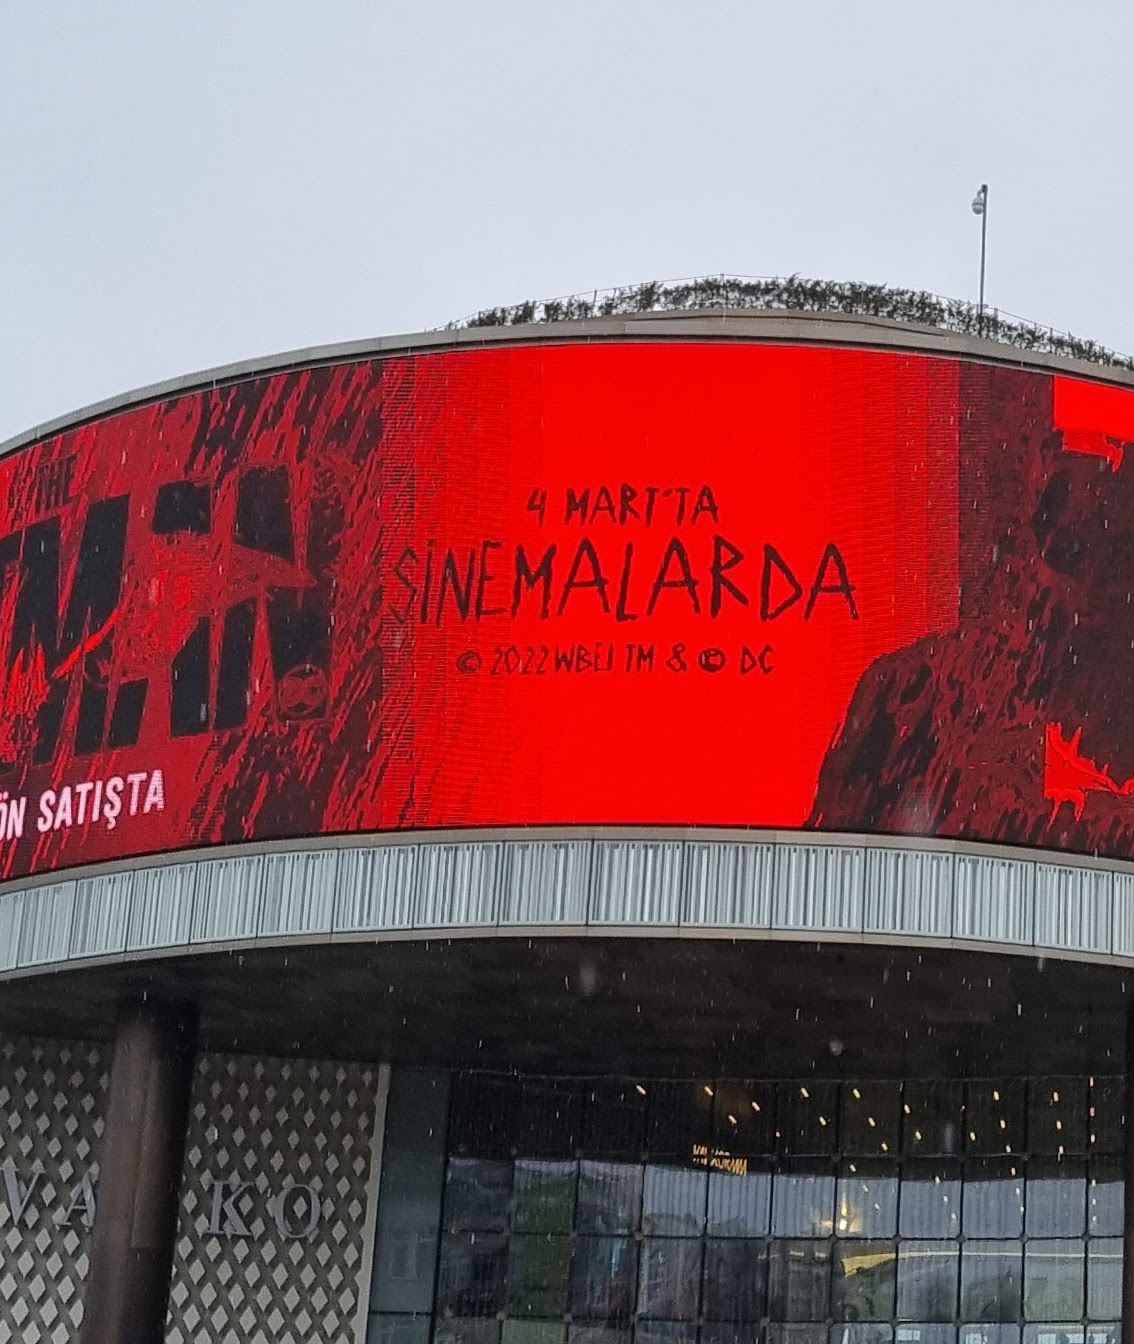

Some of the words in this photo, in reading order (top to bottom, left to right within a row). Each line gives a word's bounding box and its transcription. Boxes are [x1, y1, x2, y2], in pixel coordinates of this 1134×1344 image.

[526, 487, 546, 527] 4
[625, 643, 656, 674] TM
[666, 641, 688, 674] &
[740, 644, 775, 676] DC
[37, 769, 165, 833] SATIŞTA
[1, 1166, 321, 1239] VAKO
